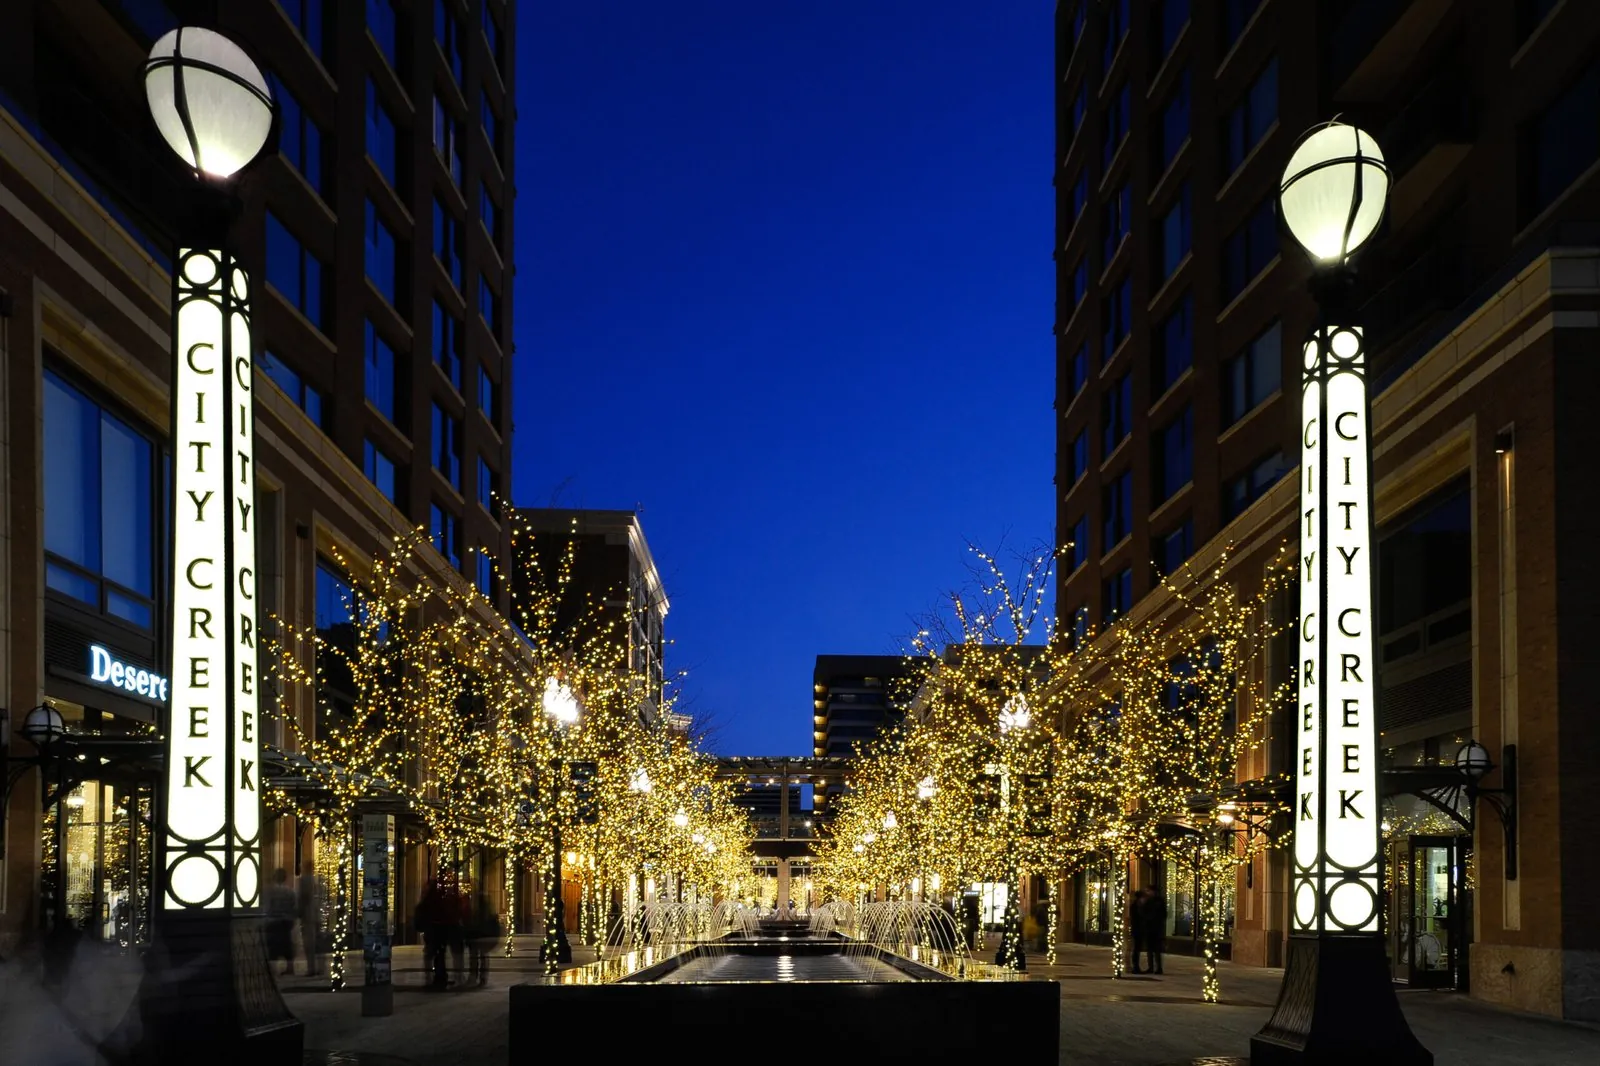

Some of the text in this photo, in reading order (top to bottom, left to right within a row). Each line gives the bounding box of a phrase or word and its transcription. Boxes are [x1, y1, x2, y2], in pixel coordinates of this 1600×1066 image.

[182, 342, 215, 788] CITY CREEK
[235, 355, 255, 792] CITY CREEK
[1300, 417, 1317, 822] CITY CREEK
[1335, 411, 1364, 820] CITY CREEK
